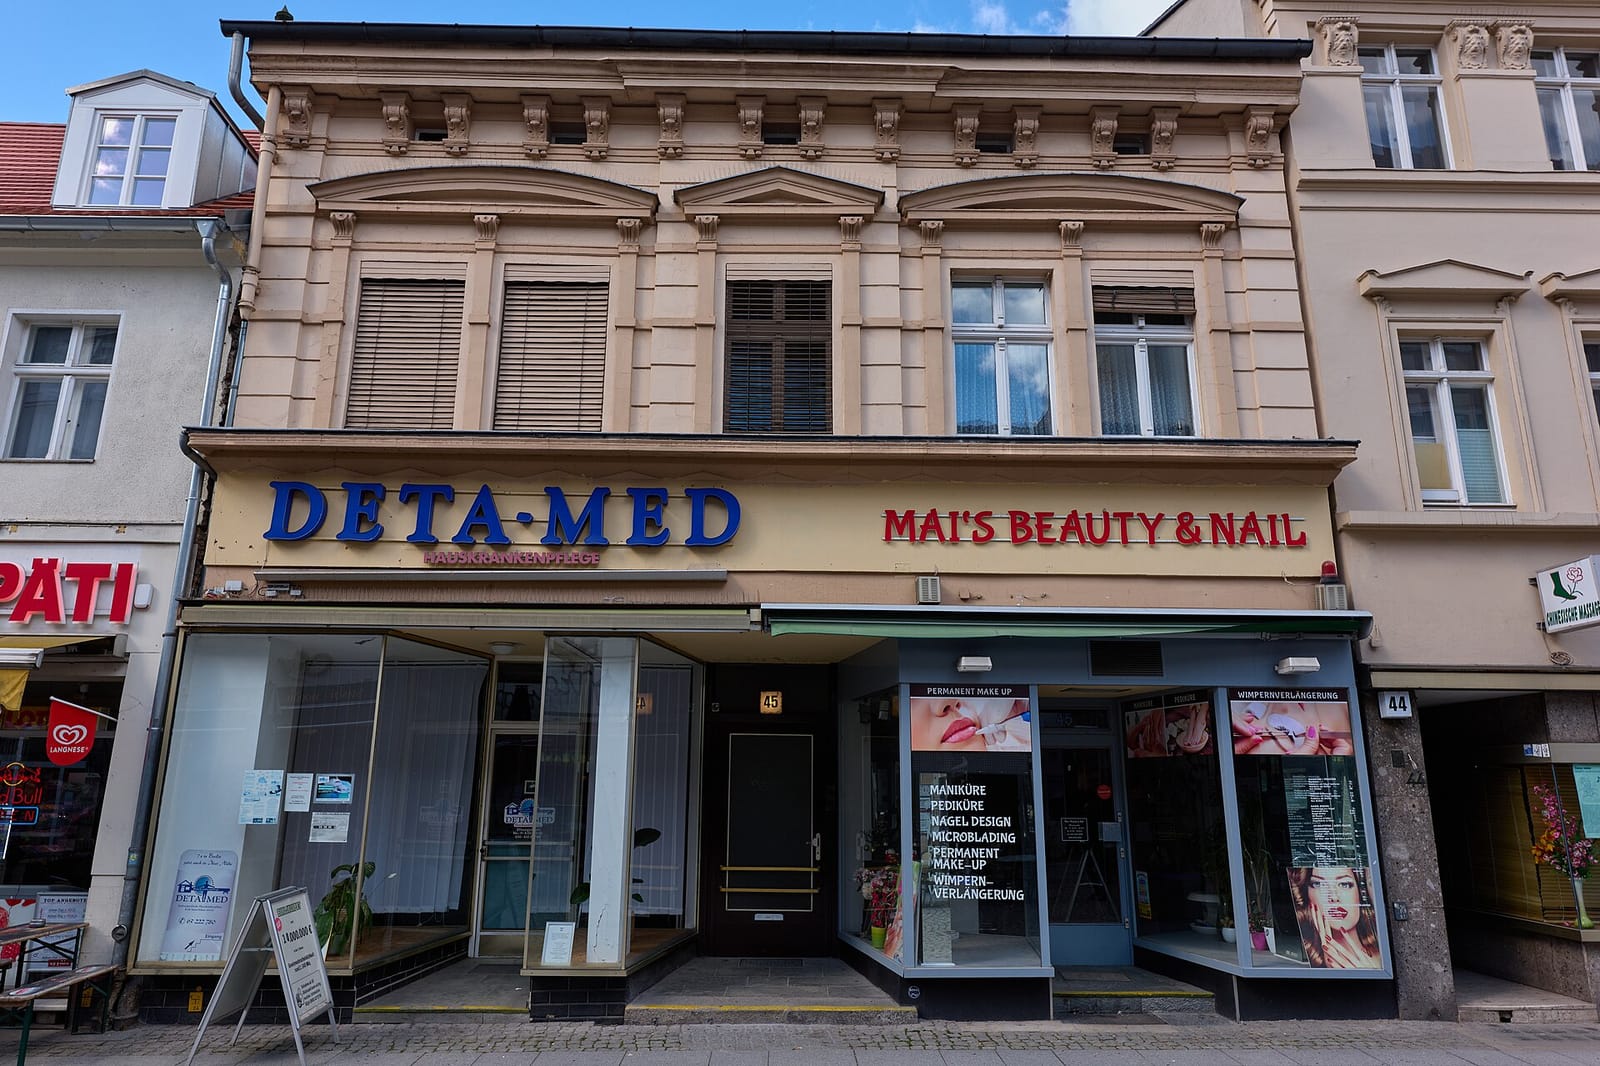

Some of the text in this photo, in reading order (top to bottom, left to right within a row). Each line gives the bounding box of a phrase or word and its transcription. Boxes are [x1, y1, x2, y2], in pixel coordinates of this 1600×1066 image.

[884, 508, 1307, 548] MAI'S BEAUTY & NAIL
[423, 551, 600, 565] HAUSKRANKENPFLEGE
[927, 687, 1012, 696] PERMANENT MAKE UP
[1237, 690, 1339, 701] WIMPERNVERLÄNGERUNG
[763, 694, 779, 709] 45
[1389, 696, 1408, 712] 44
[12, 787, 43, 805] Bull
[929, 783, 987, 796] MANIKÜRE
[930, 799, 985, 811] PEDIKÜRE
[931, 815, 1012, 828] NAGEL DESIGN
[932, 831, 1016, 844] MICROBLADING
[933, 847, 1000, 859] PERMANENT
[934, 887, 1025, 901] VERLÄNGERUNG
